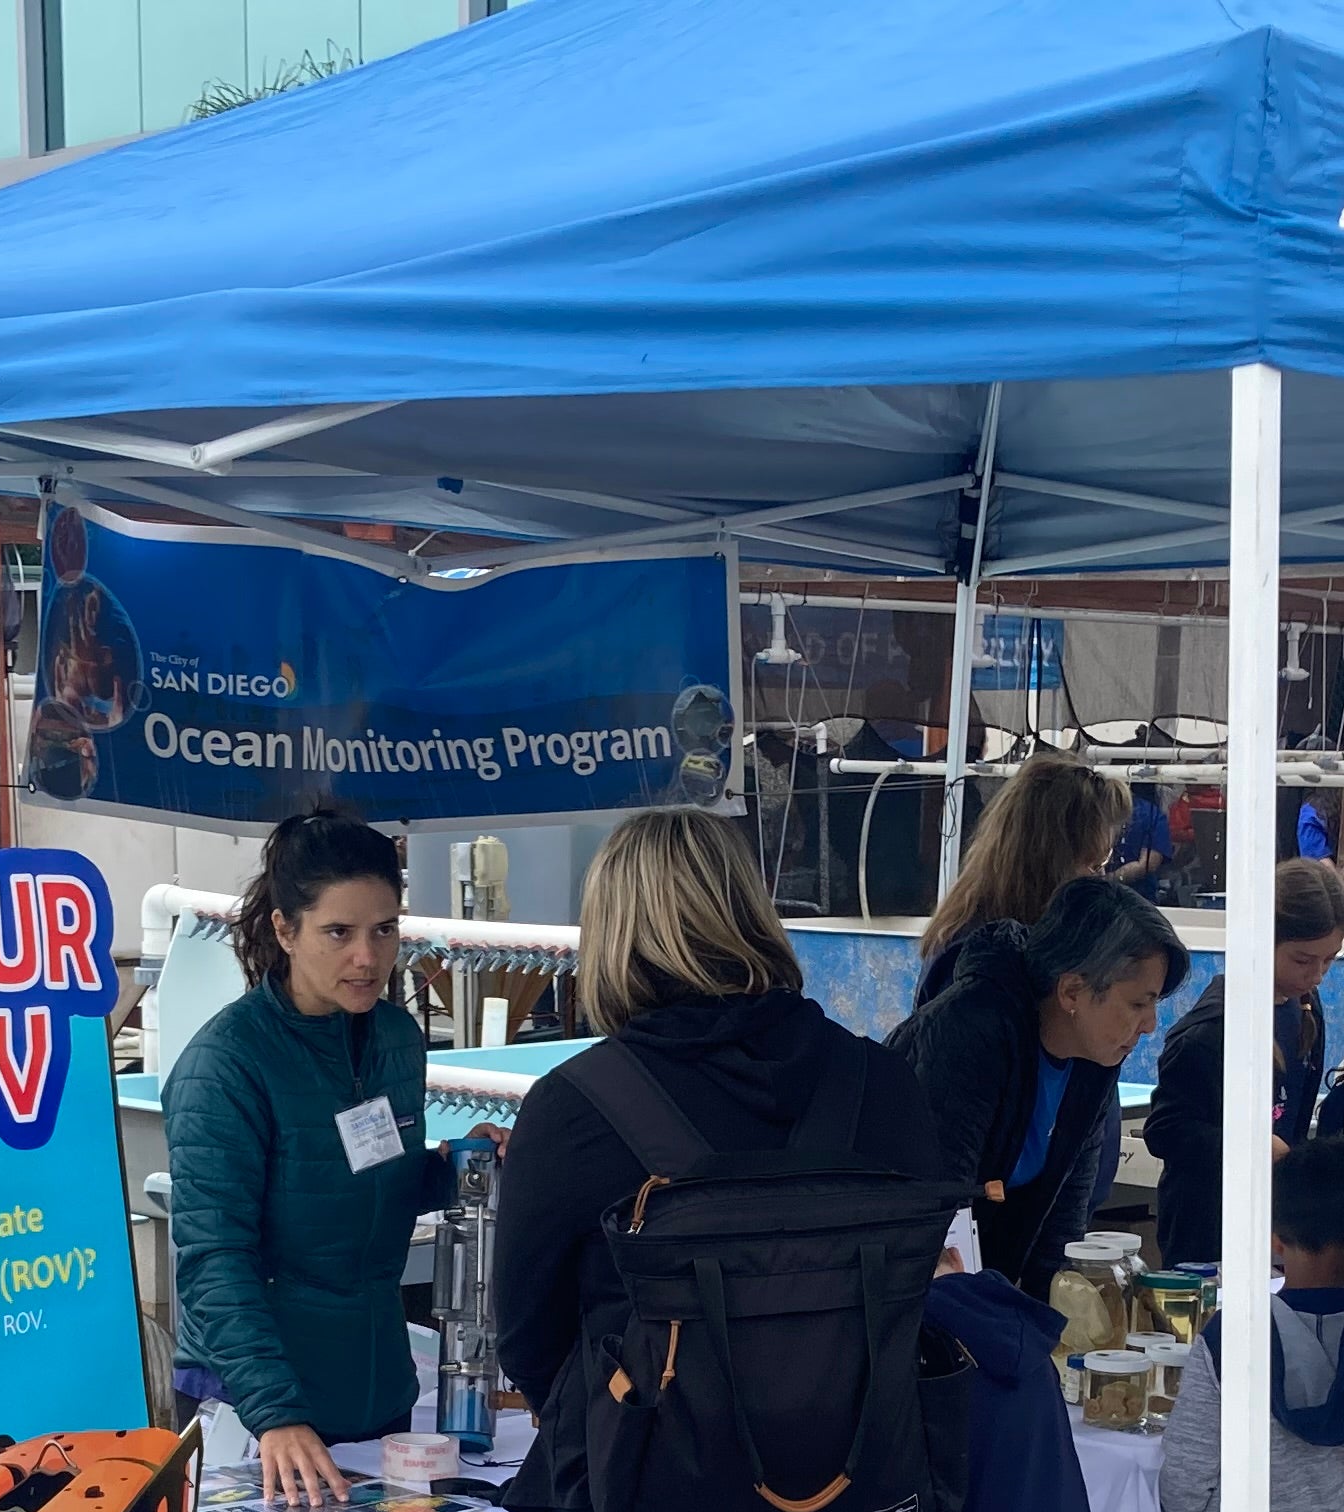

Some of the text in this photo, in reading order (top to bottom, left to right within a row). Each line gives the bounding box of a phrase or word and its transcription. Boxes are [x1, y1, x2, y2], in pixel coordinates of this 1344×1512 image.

[168, 655, 188, 667] City
[151, 667, 289, 699] SAN DIEGO
[144, 712, 672, 781] Ocean Monitoring Program
[0, 1247, 97, 1304] (ROV)?
[4, 1308, 48, 1337] ROV.
